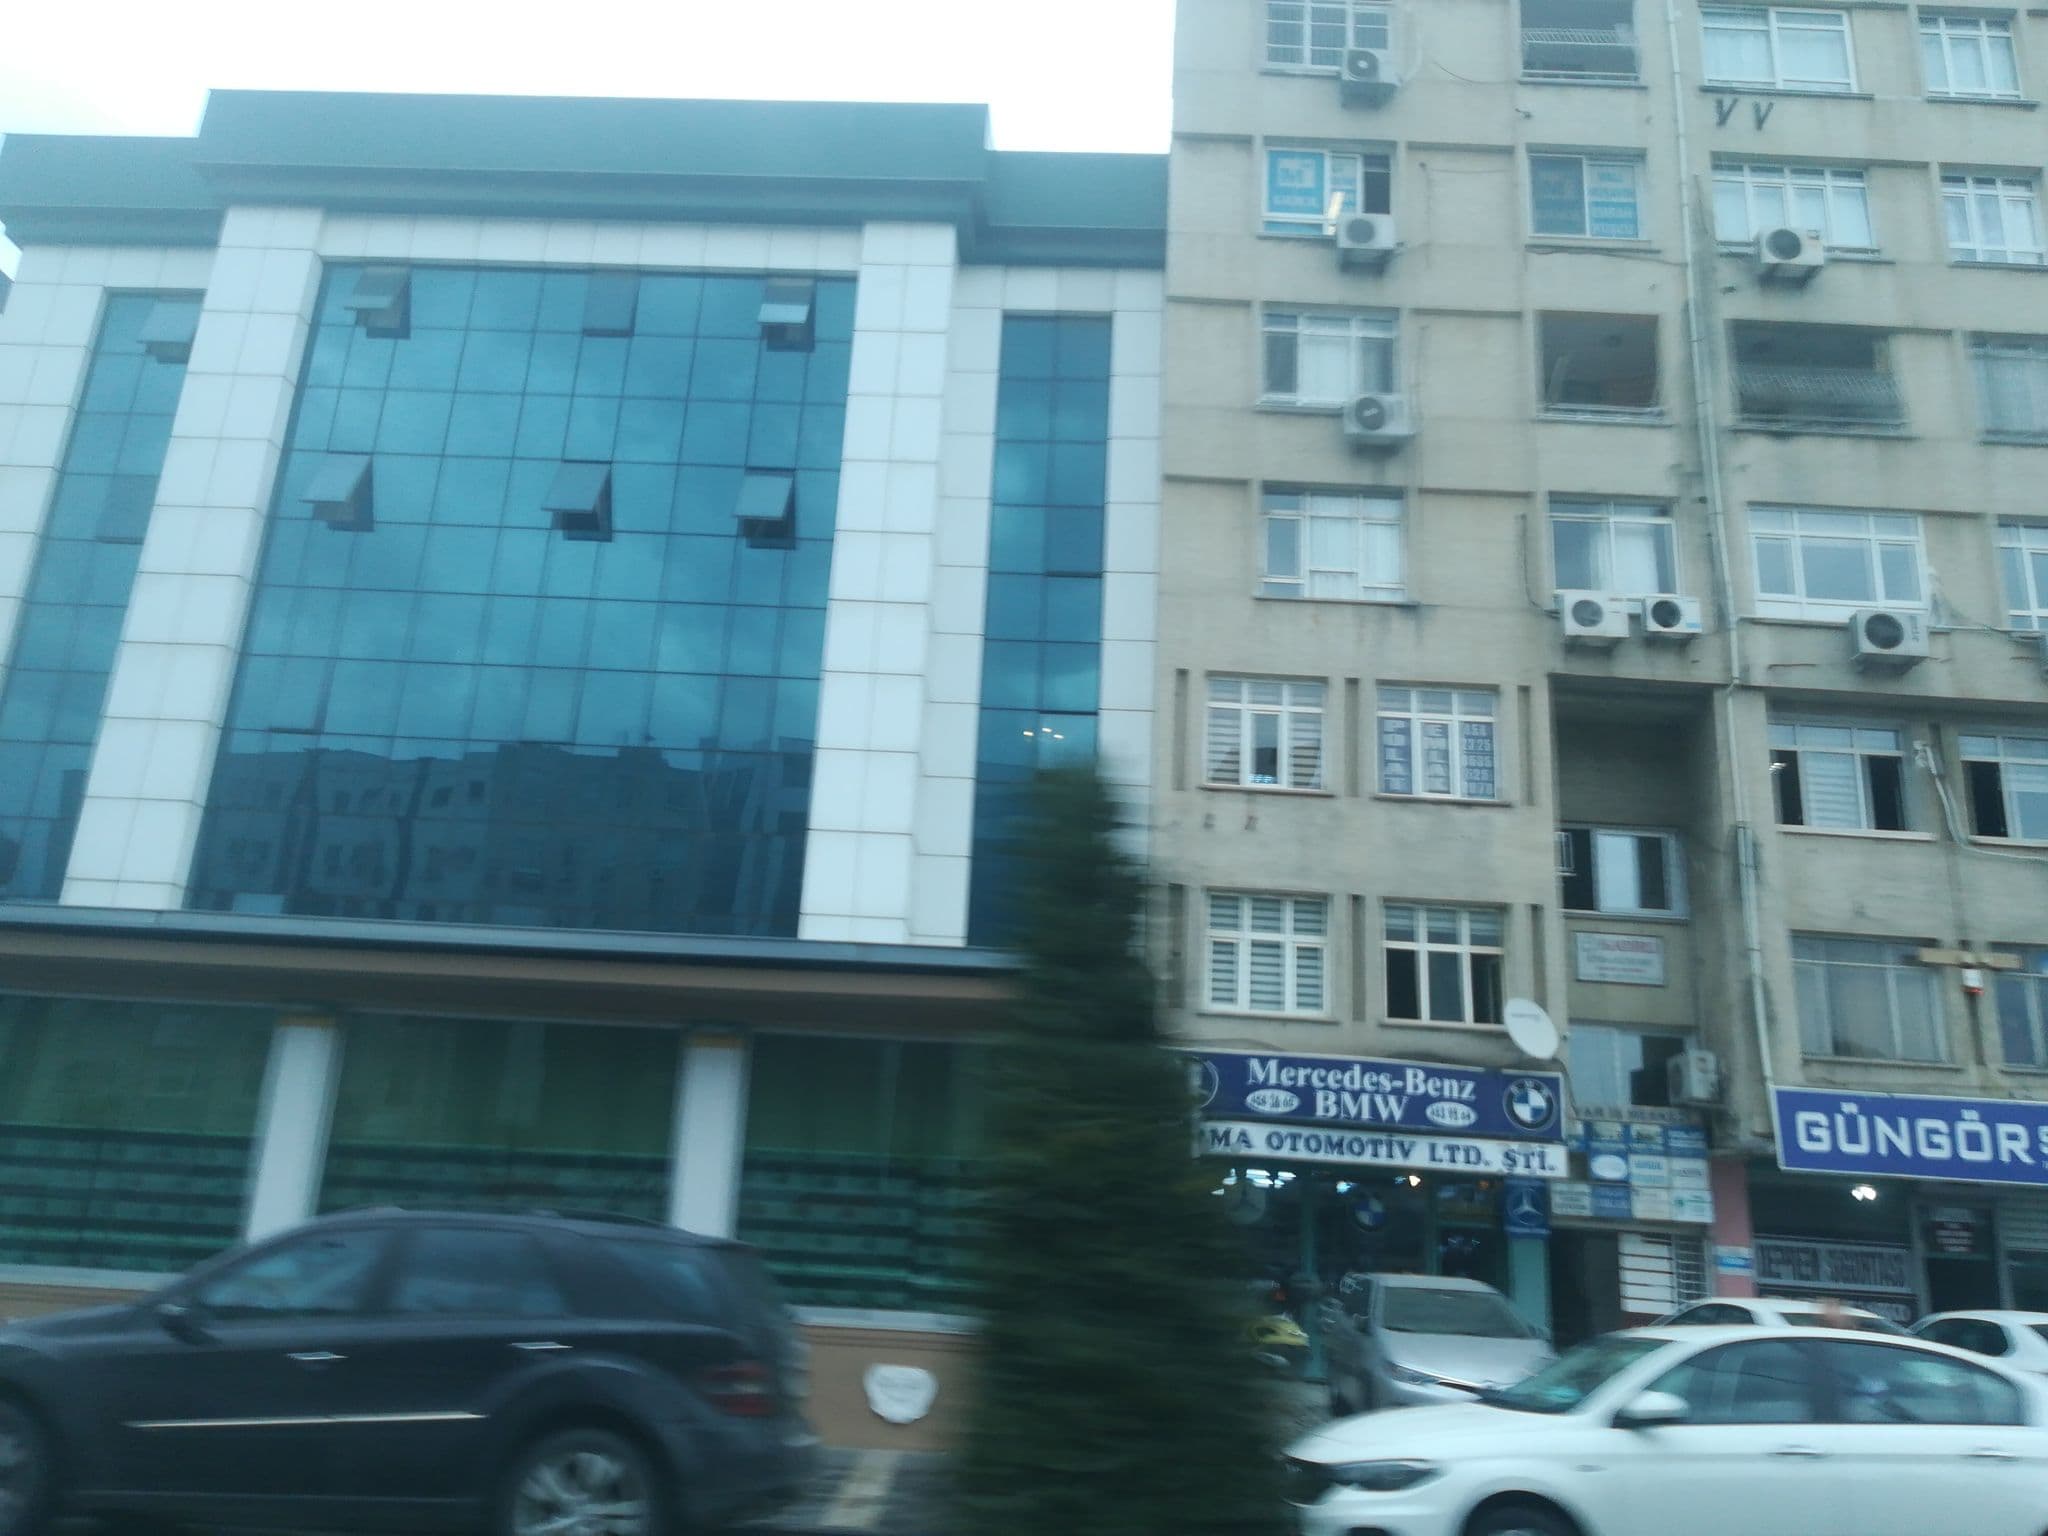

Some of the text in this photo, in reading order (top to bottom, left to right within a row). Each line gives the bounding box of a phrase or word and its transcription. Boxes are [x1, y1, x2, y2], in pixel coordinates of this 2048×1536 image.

[1247, 1058, 1476, 1101] Mercedes-Benz
[1314, 1089, 1408, 1123] BMW
[1202, 1127, 1253, 1149] MA
[1265, 1130, 1416, 1162] OTOMOTİV
[1428, 1143, 1492, 1167] LTD.
[1795, 1101, 2035, 1164] GÜNGÖR
